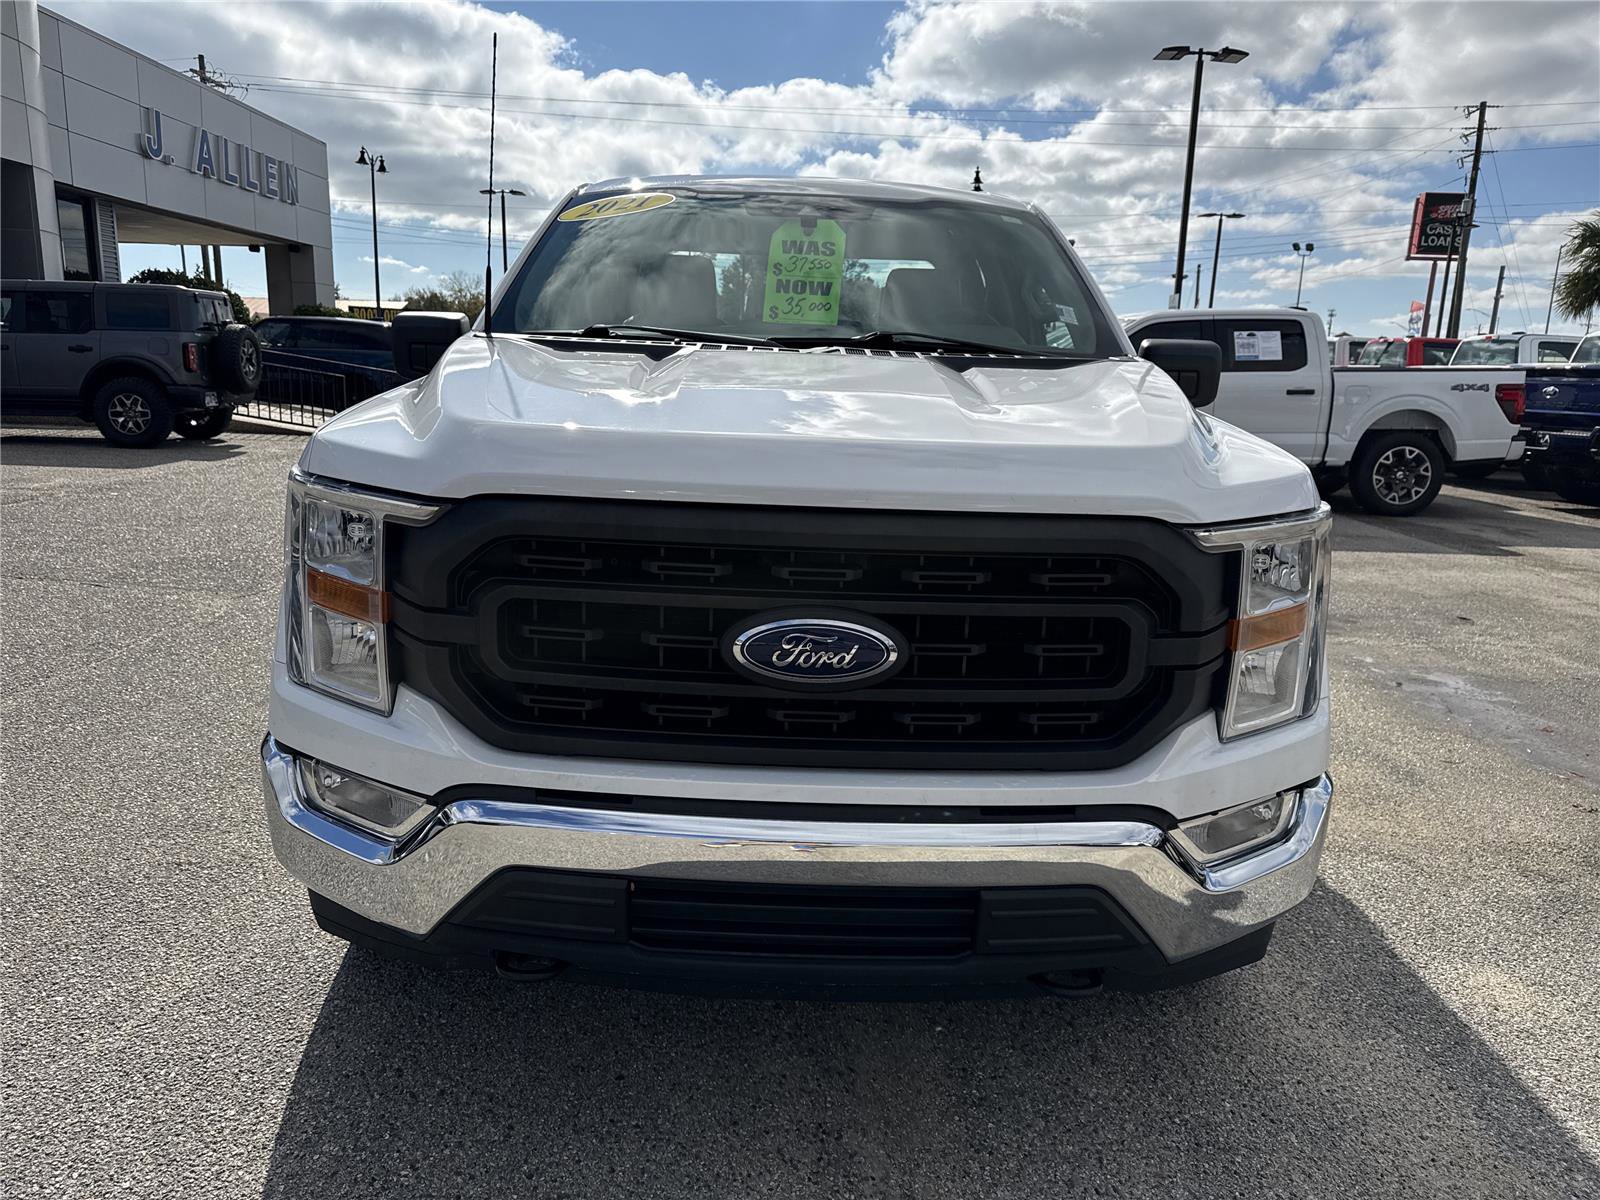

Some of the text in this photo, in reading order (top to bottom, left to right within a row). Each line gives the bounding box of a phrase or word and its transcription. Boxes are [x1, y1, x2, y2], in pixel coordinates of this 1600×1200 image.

[144, 108, 299, 206] J. ALLEN
[574, 195, 653, 219] 2021
[781, 240, 836, 256] WAS
[775, 279, 833, 296] NOW
[772, 633, 859, 669] Ford
